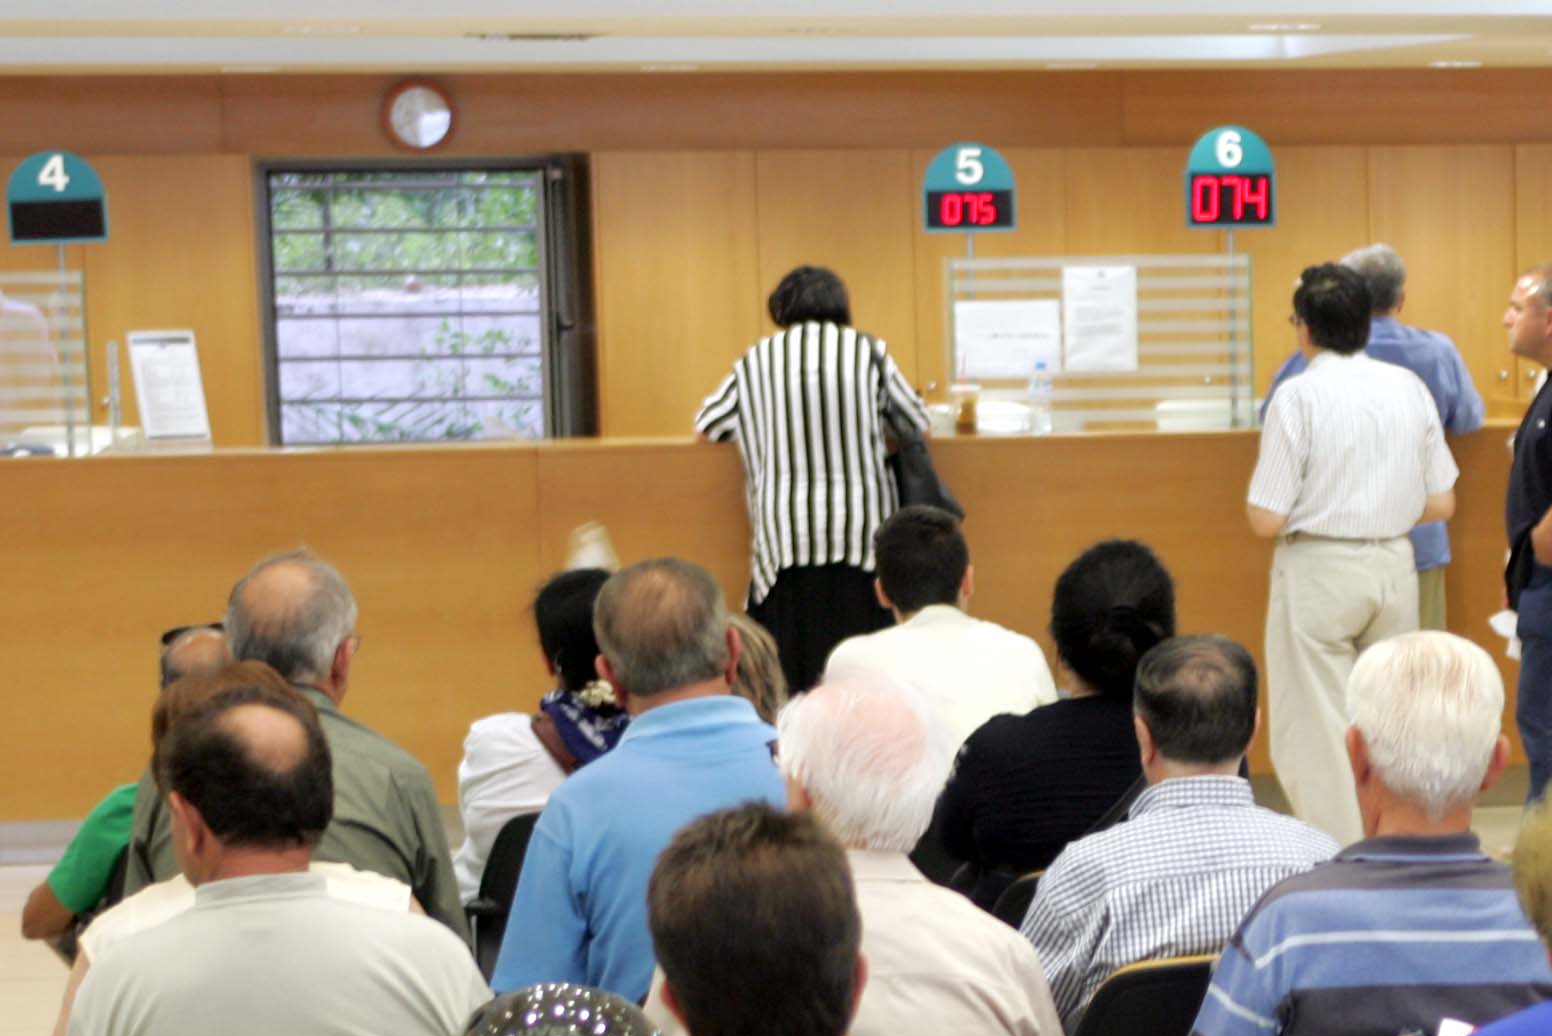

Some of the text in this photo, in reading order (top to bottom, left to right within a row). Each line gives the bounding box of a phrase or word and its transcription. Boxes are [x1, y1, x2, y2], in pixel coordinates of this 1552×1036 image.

[954, 147, 984, 185] 5
[1215, 129, 1243, 168] 6
[38, 154, 70, 192] 4
[940, 192, 997, 226] 075
[1191, 174, 1269, 223] 074
